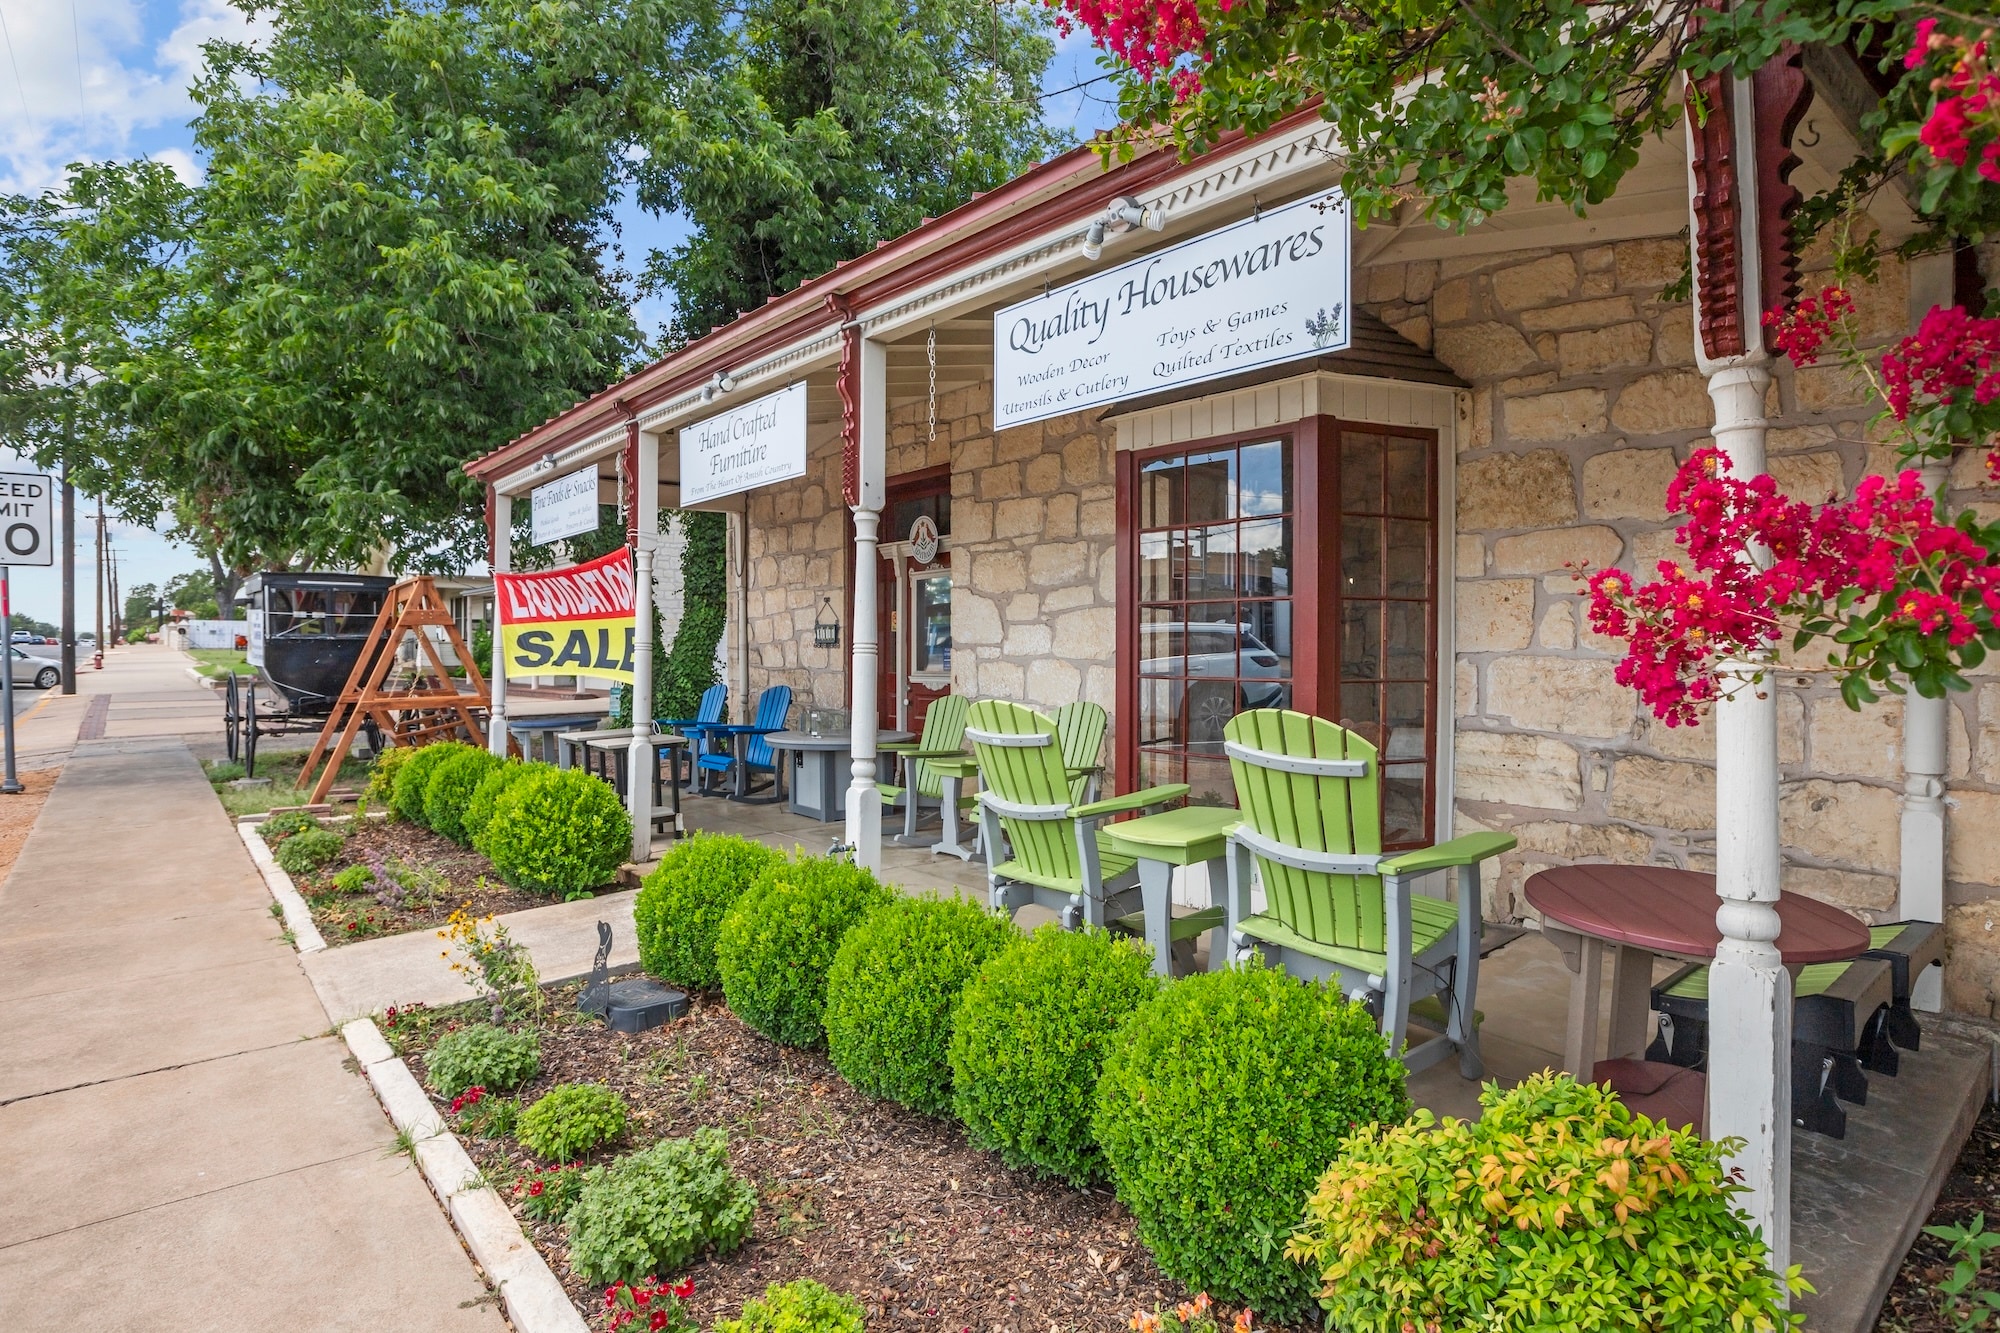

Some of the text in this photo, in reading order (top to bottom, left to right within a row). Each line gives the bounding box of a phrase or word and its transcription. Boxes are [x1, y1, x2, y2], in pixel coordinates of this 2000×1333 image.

[1009, 225, 1325, 354] Quality Housewares
[1156, 302, 1289, 349] Toys & Games
[1016, 352, 1111, 388] Wooden Decor
[1152, 331, 1294, 378] Quilted Textiles
[1002, 373, 1130, 416] Utensils & Cutlery
[698, 397, 781, 452] Hand Crafted
[690, 487, 705, 496] From
[706, 481, 717, 493] The
[718, 478, 735, 490] Heart
[743, 468, 763, 482] Amish
[764, 462, 792, 475] Country
[709, 444, 768, 475] Furniture
[533, 470, 596, 511] Fine Foods & Snacks
[505, 558, 635, 620] LIQUIDATION
